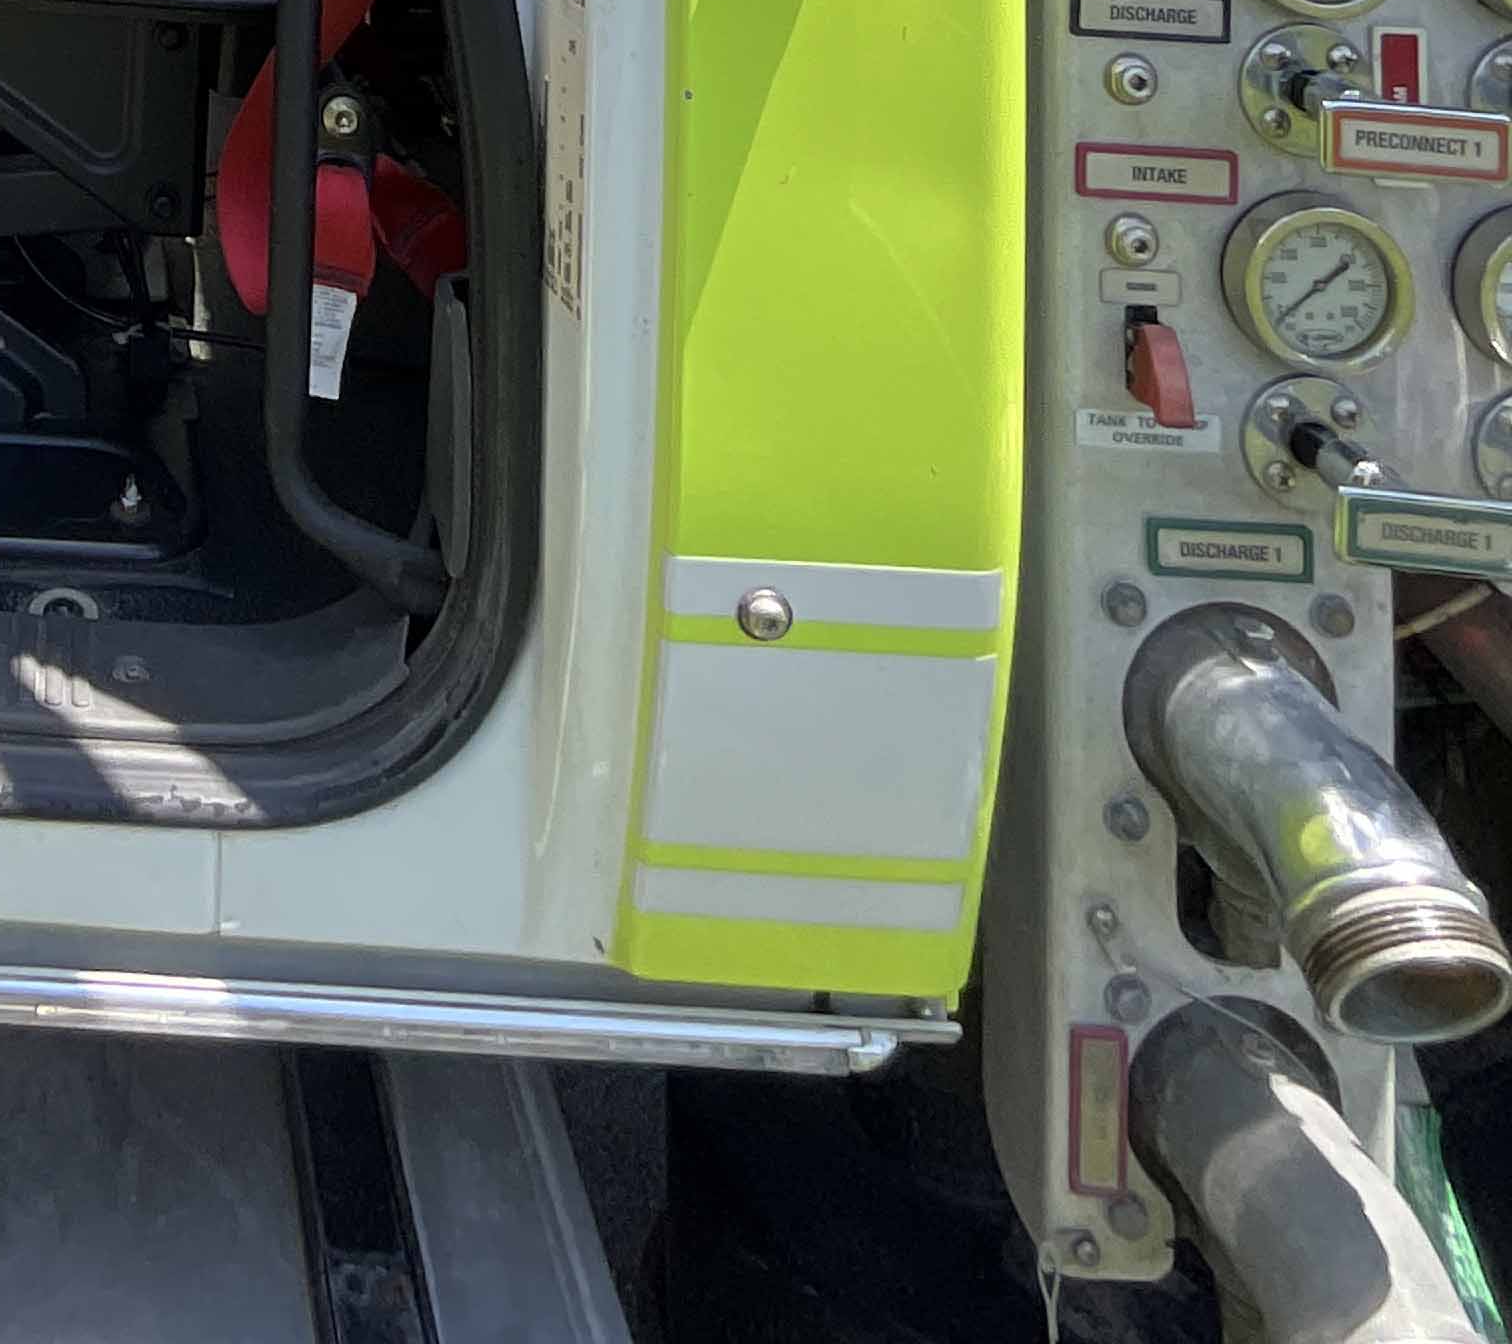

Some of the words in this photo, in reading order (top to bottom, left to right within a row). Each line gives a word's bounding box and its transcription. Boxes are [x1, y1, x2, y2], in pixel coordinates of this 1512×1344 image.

[1110, 5, 1197, 25] DISCHARGE
[1355, 129, 1468, 157] PRECONNECT
[1473, 141, 1482, 158] 1
[1131, 165, 1187, 184] INTAKE
[1089, 413, 1126, 427] TANK
[1112, 431, 1184, 446] OVERRIDE
[1381, 522, 1480, 550] DISCHARGE
[1483, 534, 1492, 551] 1
[1180, 541, 1270, 561] DISCHARGE
[1273, 547, 1282, 563] 1
